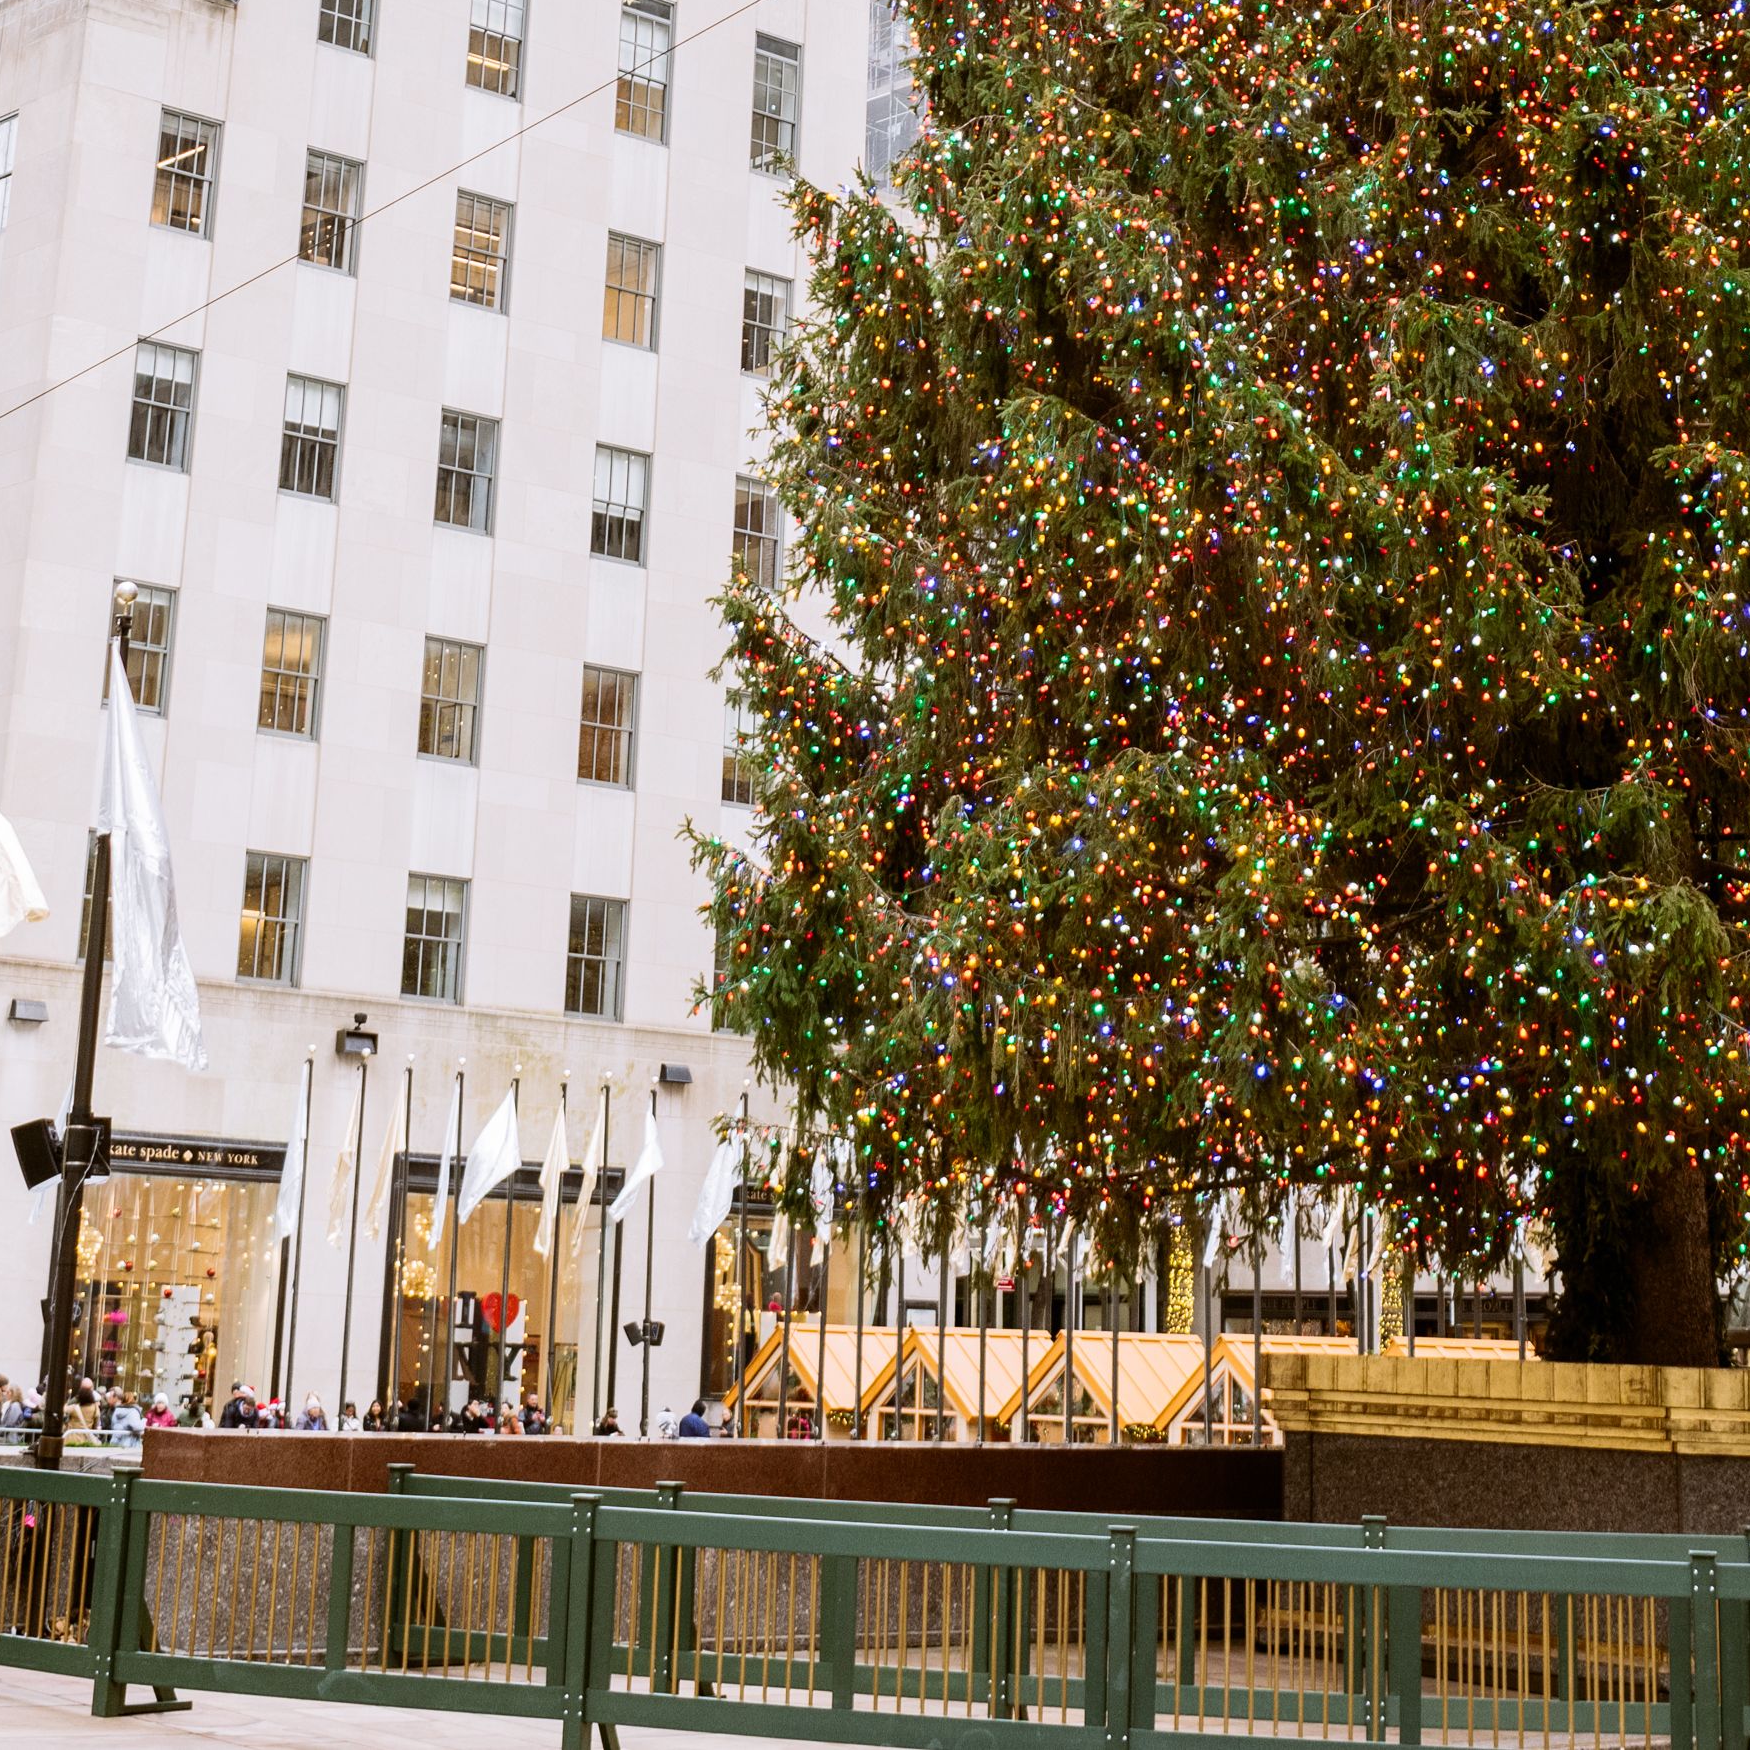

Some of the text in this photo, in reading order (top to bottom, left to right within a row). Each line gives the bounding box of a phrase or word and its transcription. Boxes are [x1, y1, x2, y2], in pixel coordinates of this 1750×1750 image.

[139, 1144, 180, 1162] spade
[197, 1150, 224, 1162] NEW
[227, 1152, 259, 1166] YORK
